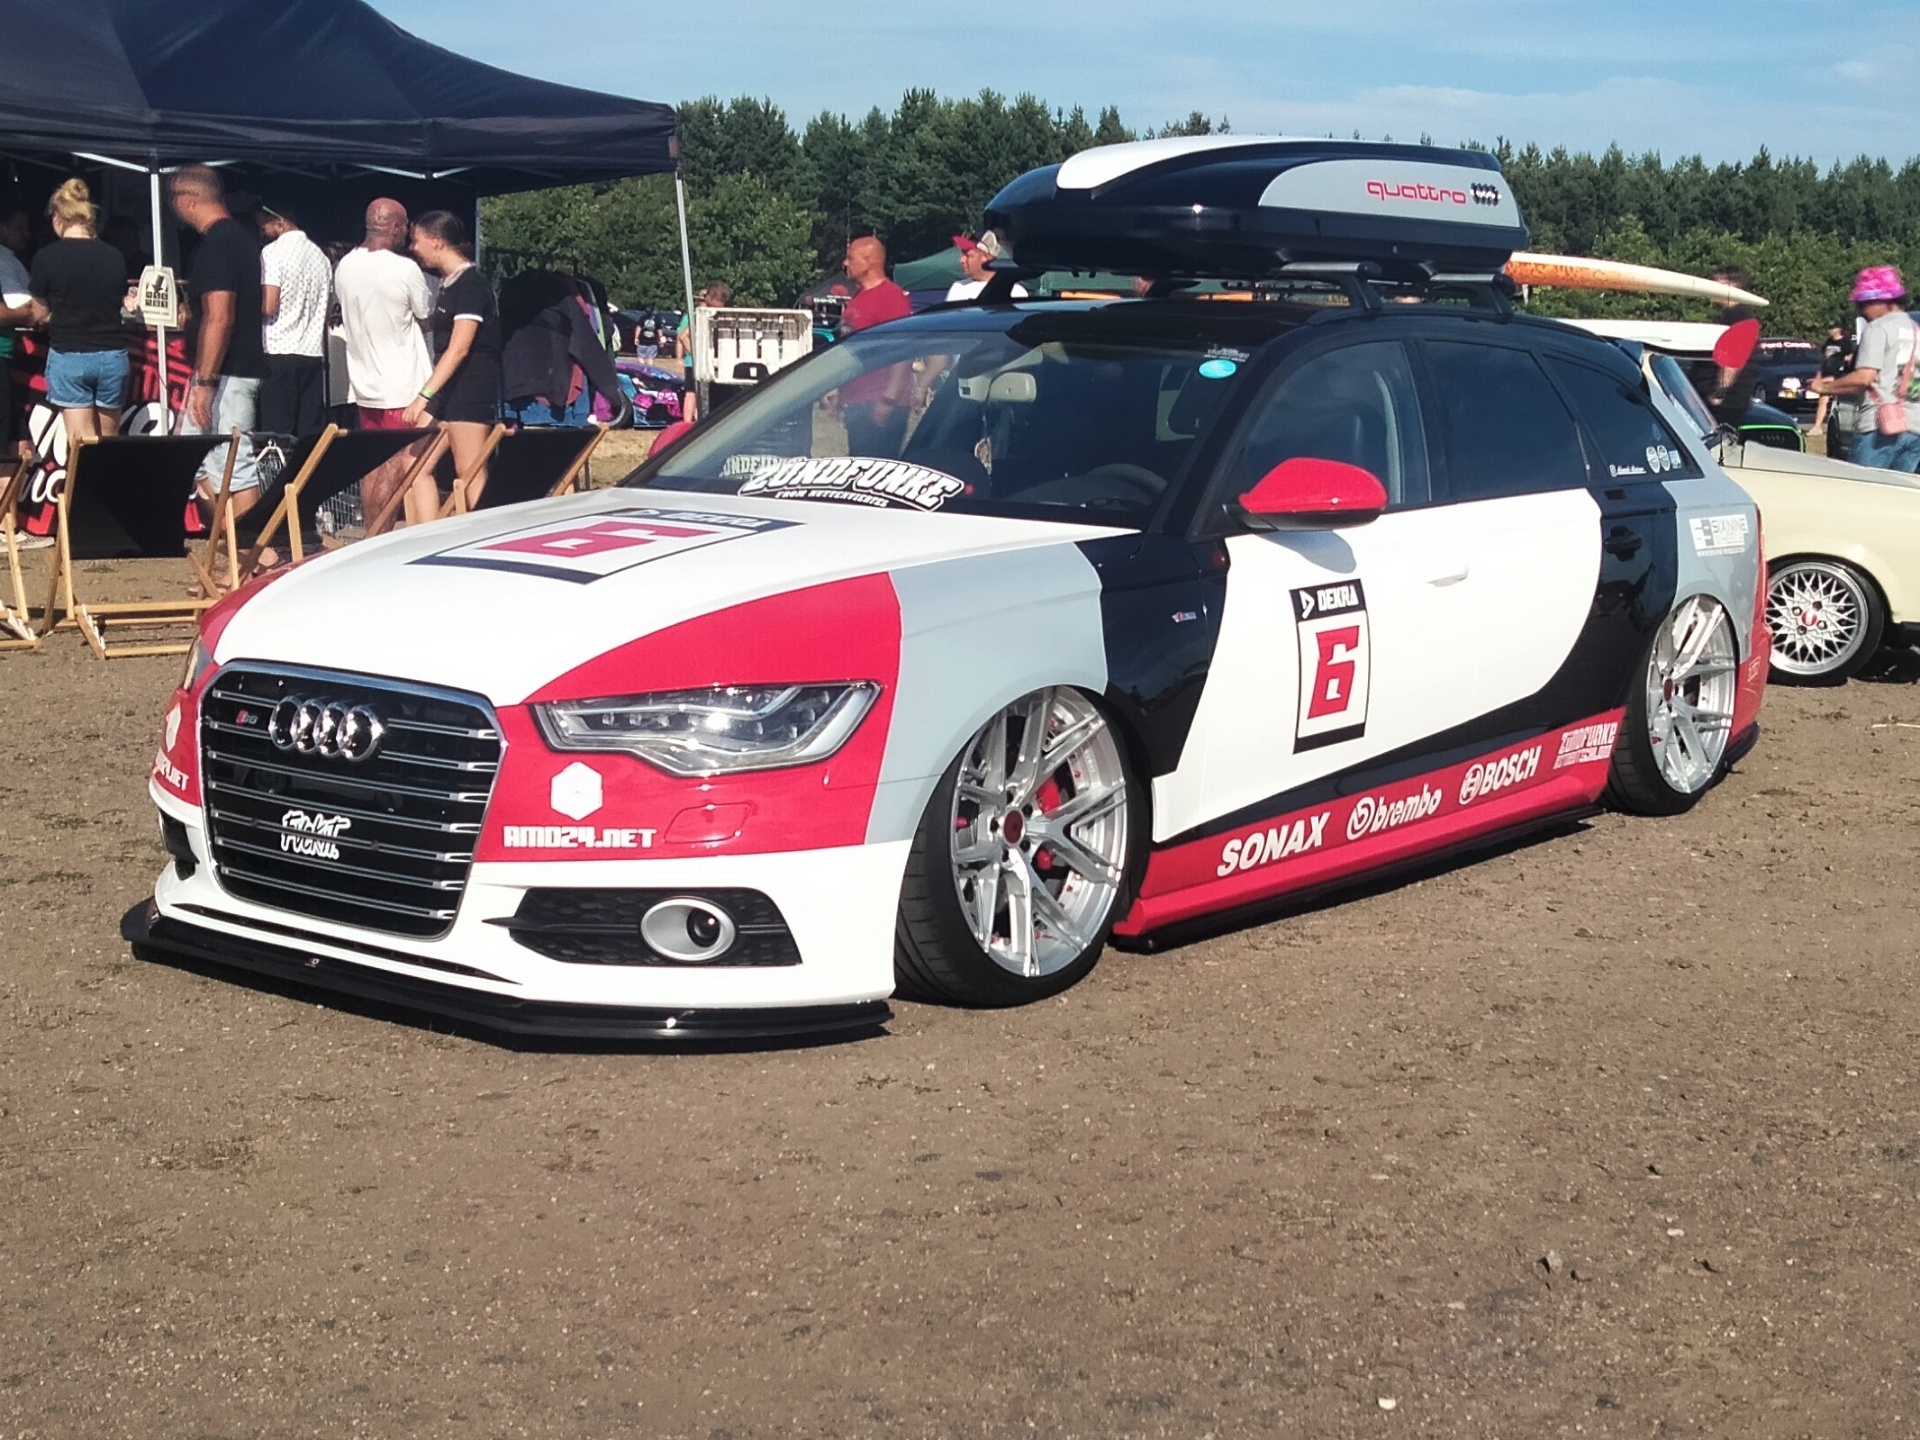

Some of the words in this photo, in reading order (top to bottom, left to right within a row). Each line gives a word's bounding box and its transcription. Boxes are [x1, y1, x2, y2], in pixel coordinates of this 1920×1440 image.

[1366, 182, 1466, 205] quattro
[774, 489, 808, 499] FROM
[474, 520, 721, 558] 6
[1316, 584, 1360, 612] DEKRA
[1306, 624, 1361, 720] 6
[1479, 746, 1542, 796] BOSCH
[1370, 783, 1443, 833] brembo
[1217, 812, 1331, 877] SONAX
